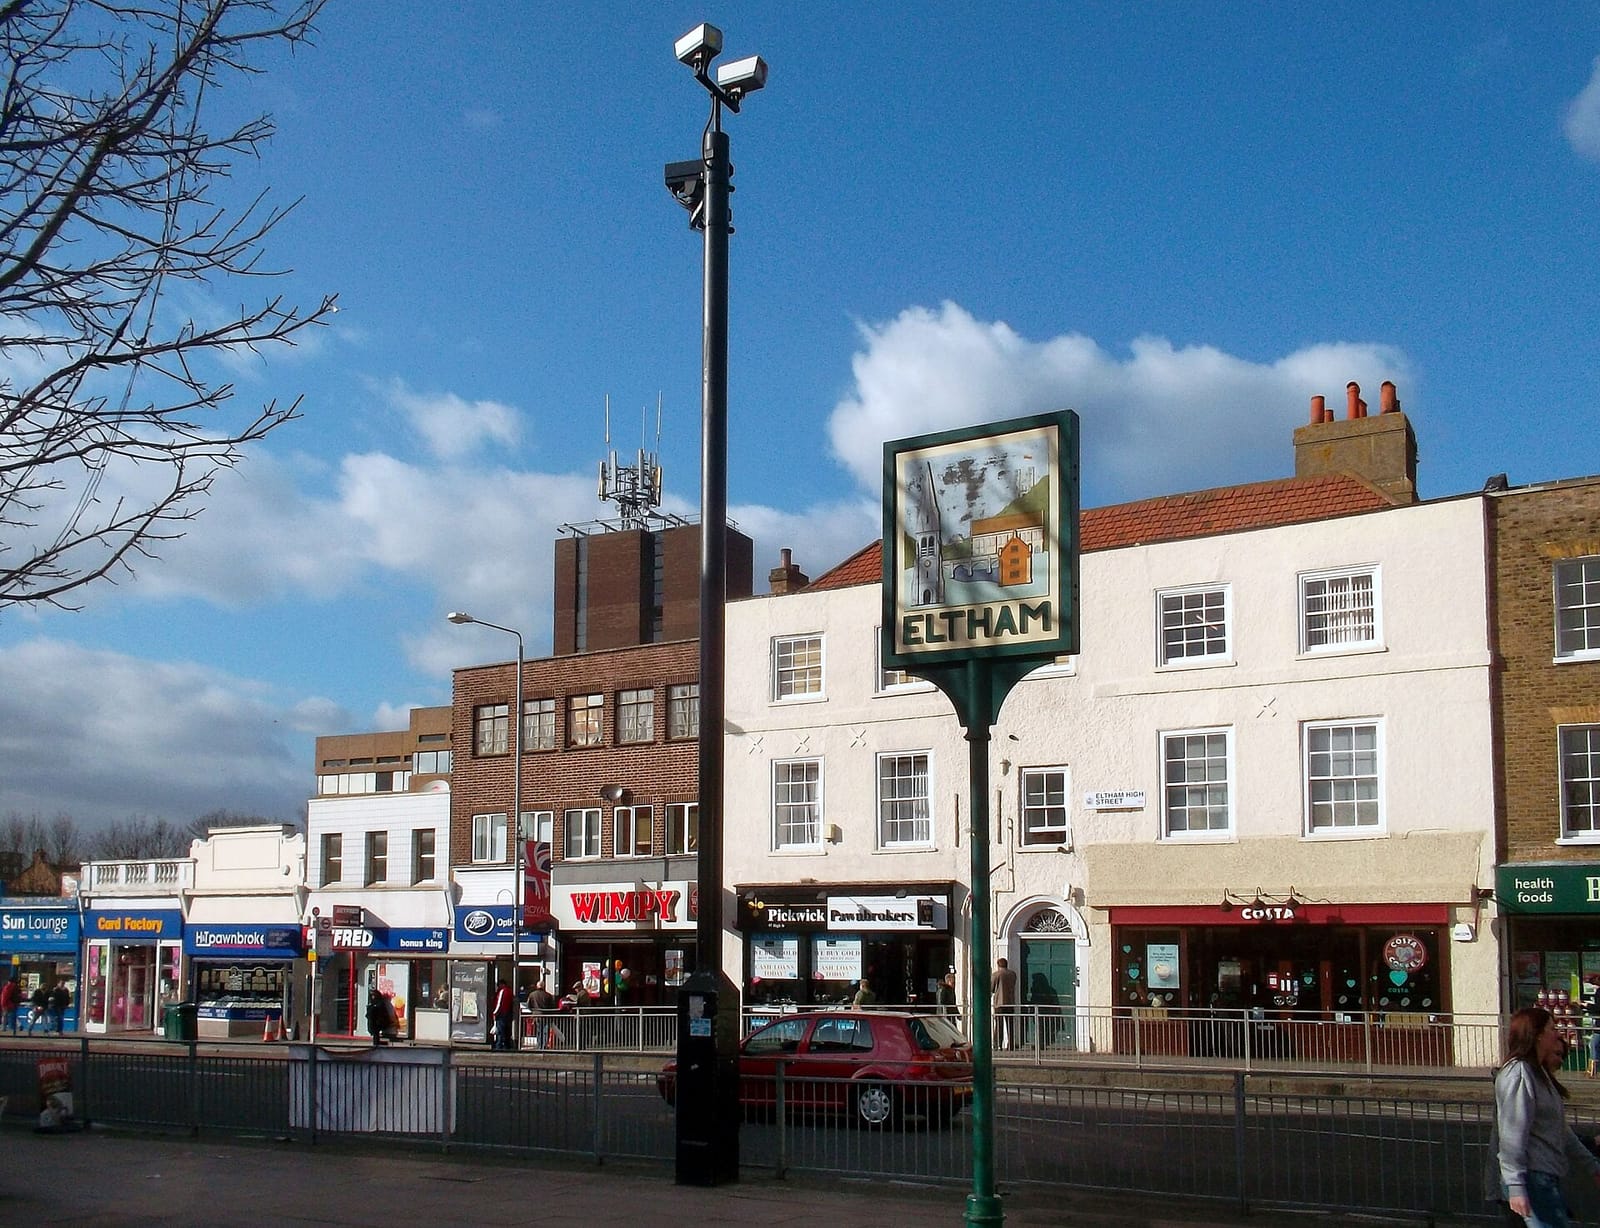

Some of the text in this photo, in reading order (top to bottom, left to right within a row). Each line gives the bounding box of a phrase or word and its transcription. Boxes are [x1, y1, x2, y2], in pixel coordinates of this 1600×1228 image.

[903, 600, 1052, 645] ELTHAM
[1515, 878, 1554, 889] health
[1518, 891, 1553, 903] foods
[525, 905, 549, 914] ROYAL
[569, 890, 676, 921] WIMPY
[767, 908, 916, 922] Pickwick Pawnbrokers
[1242, 907, 1295, 921] COSTA
[2, 914, 68, 934] Sun Lounge
[98, 917, 164, 934] Card Factory
[208, 930, 265, 946] pawnbroke
[432, 930, 443, 939] the
[400, 938, 443, 949] bonus king
[1390, 938, 1417, 949] COSTA
